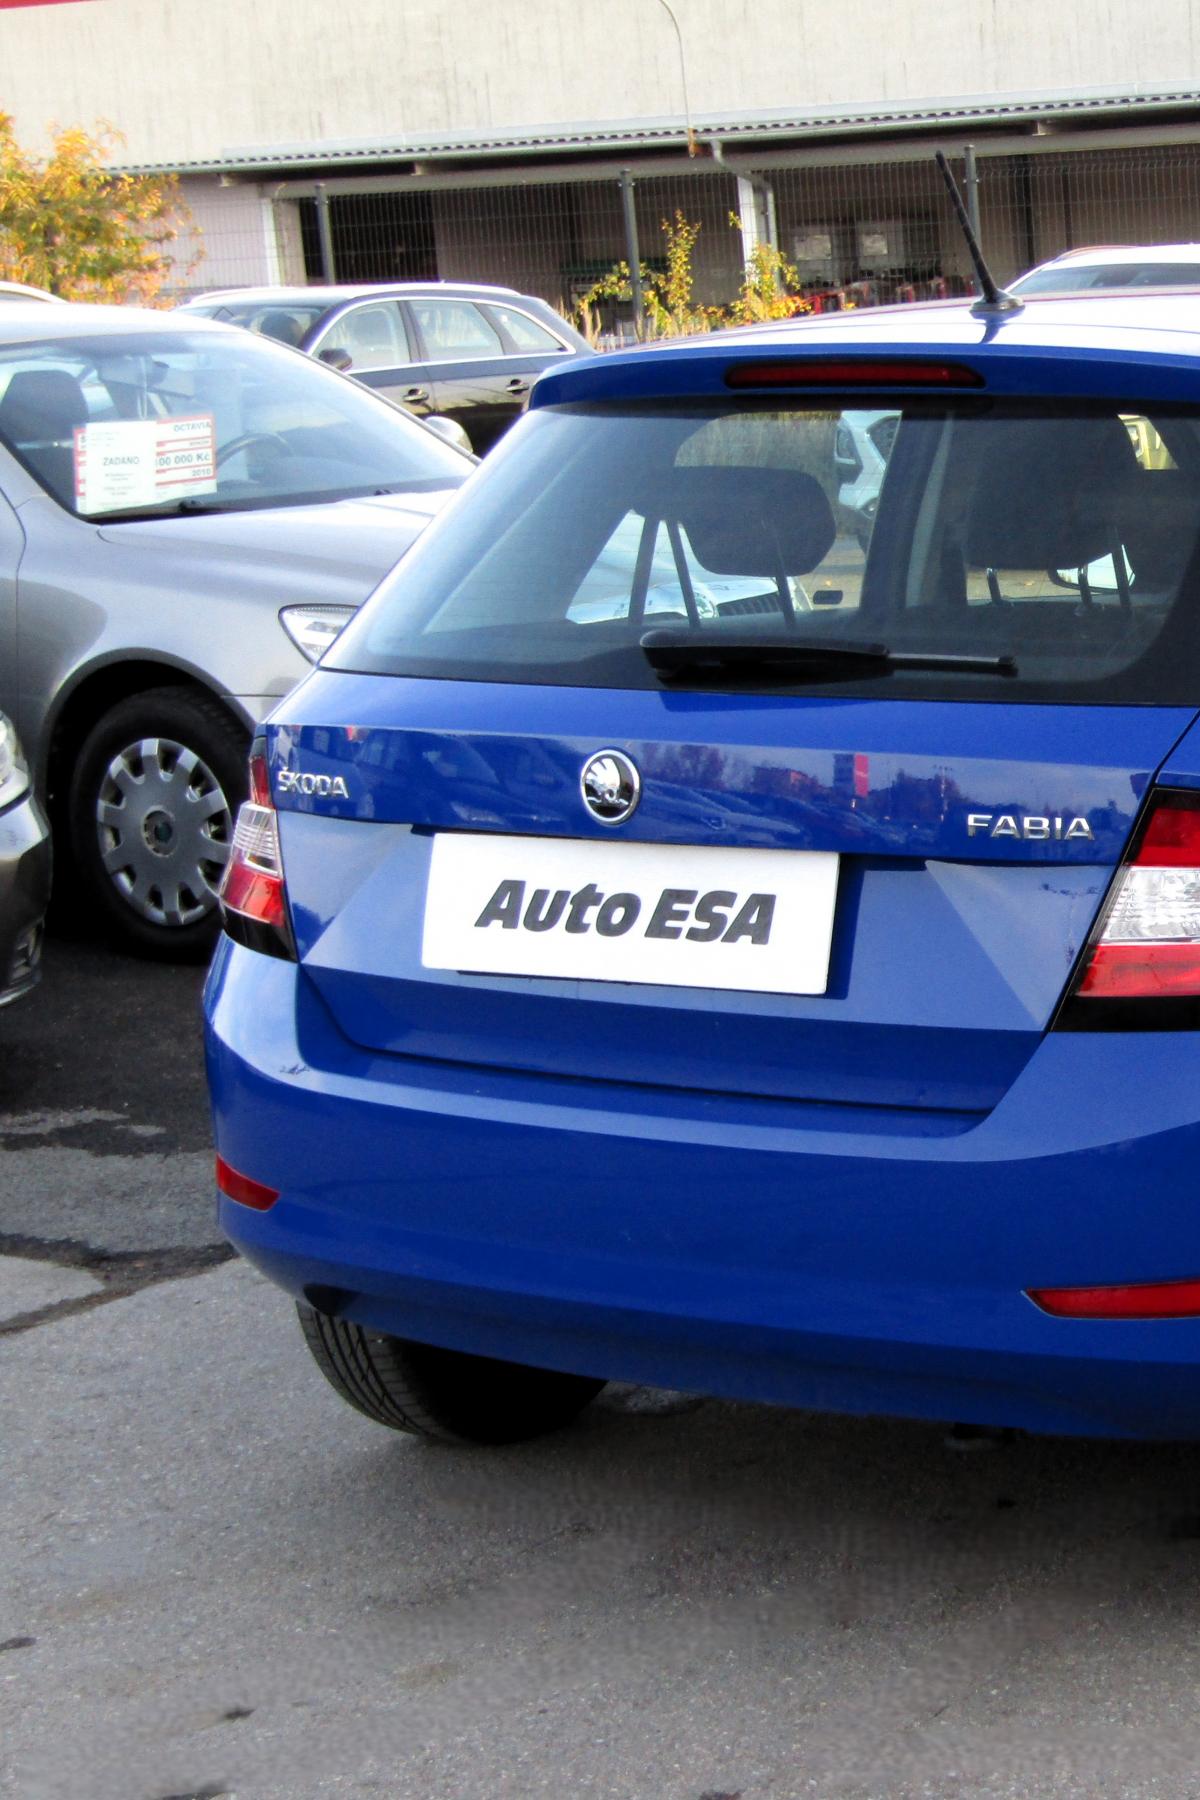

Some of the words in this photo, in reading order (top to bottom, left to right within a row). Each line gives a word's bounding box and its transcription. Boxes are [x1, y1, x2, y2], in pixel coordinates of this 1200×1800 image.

[174, 422, 211, 433] OCTAVIA
[174, 454, 193, 465] 000
[278, 766, 350, 799] ŠKODA
[967, 813, 1096, 841] FABIA
[474, 879, 641, 937] Auto
[644, 889, 777, 946] ESA
